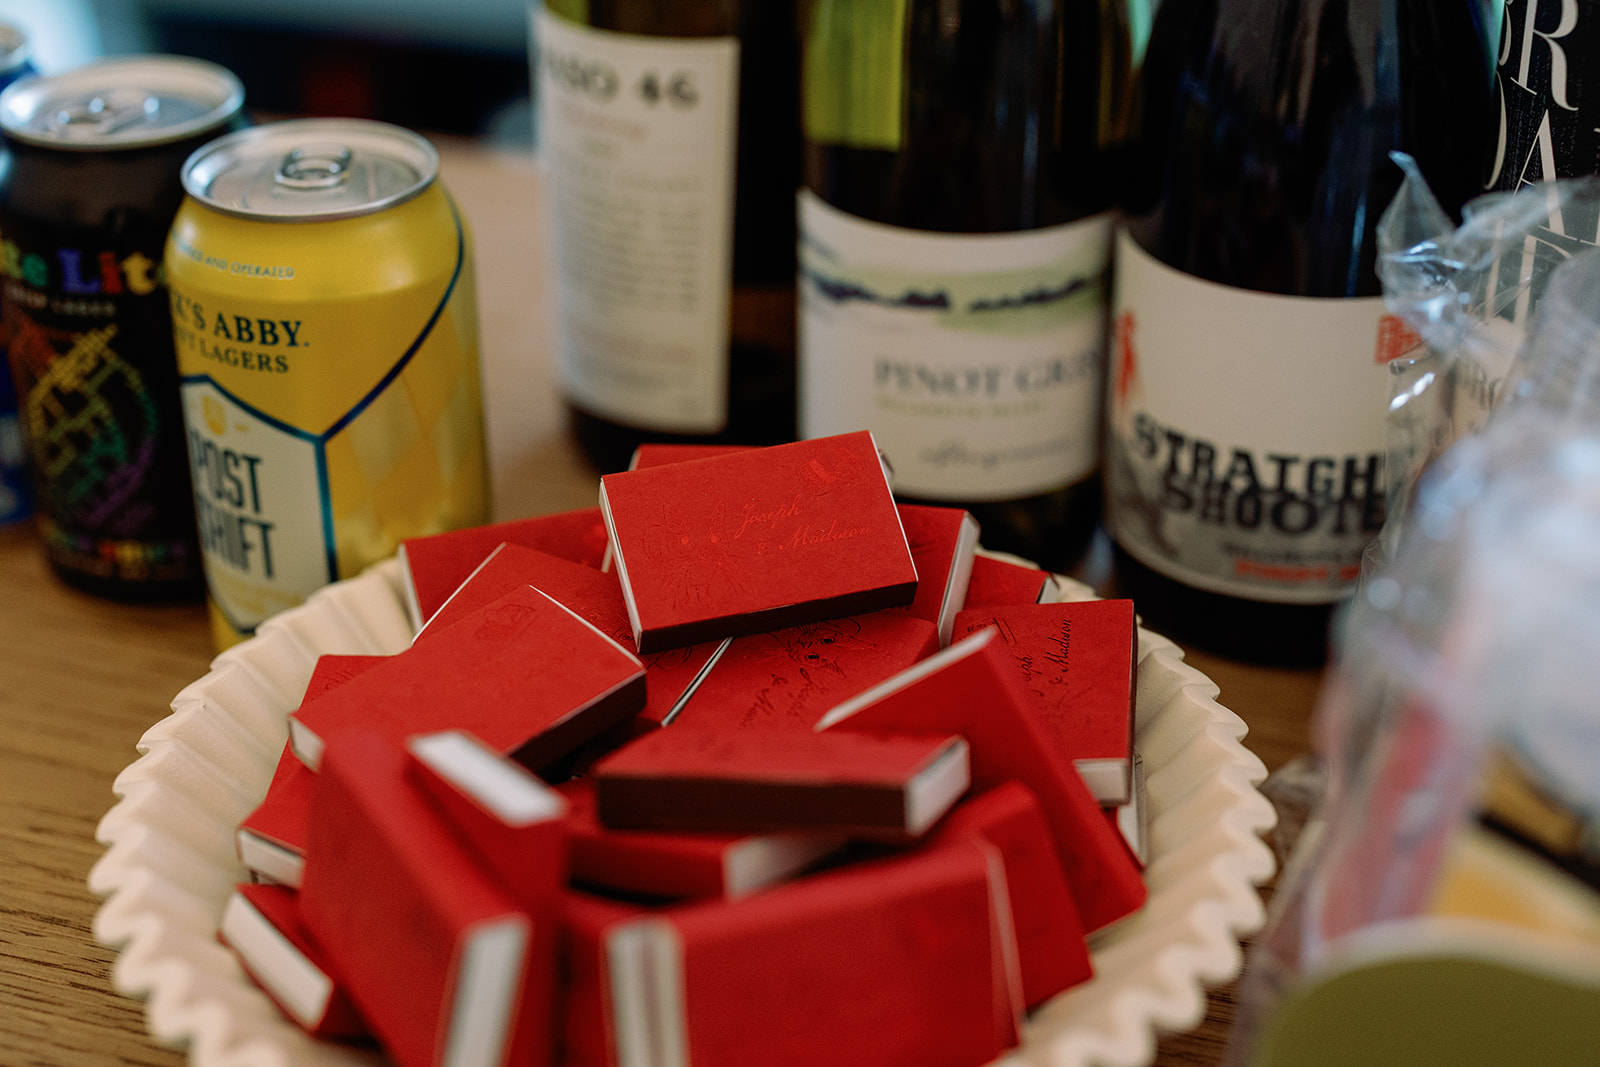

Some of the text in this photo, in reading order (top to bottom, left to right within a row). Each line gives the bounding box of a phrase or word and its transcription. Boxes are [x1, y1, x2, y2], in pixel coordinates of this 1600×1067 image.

[57, 248, 166, 295] Lit
[230, 261, 295, 280] OPERATED
[214, 311, 310, 347] ABBY.
[200, 338, 289, 374] LAGERS
[873, 357, 1001, 396] PINOT
[185, 428, 263, 516] POST
[1135, 411, 1380, 500] STRAIGH
[733, 494, 801, 540] Joseph
[778, 519, 872, 549] Madison
[1043, 618, 1072, 673] Madison
